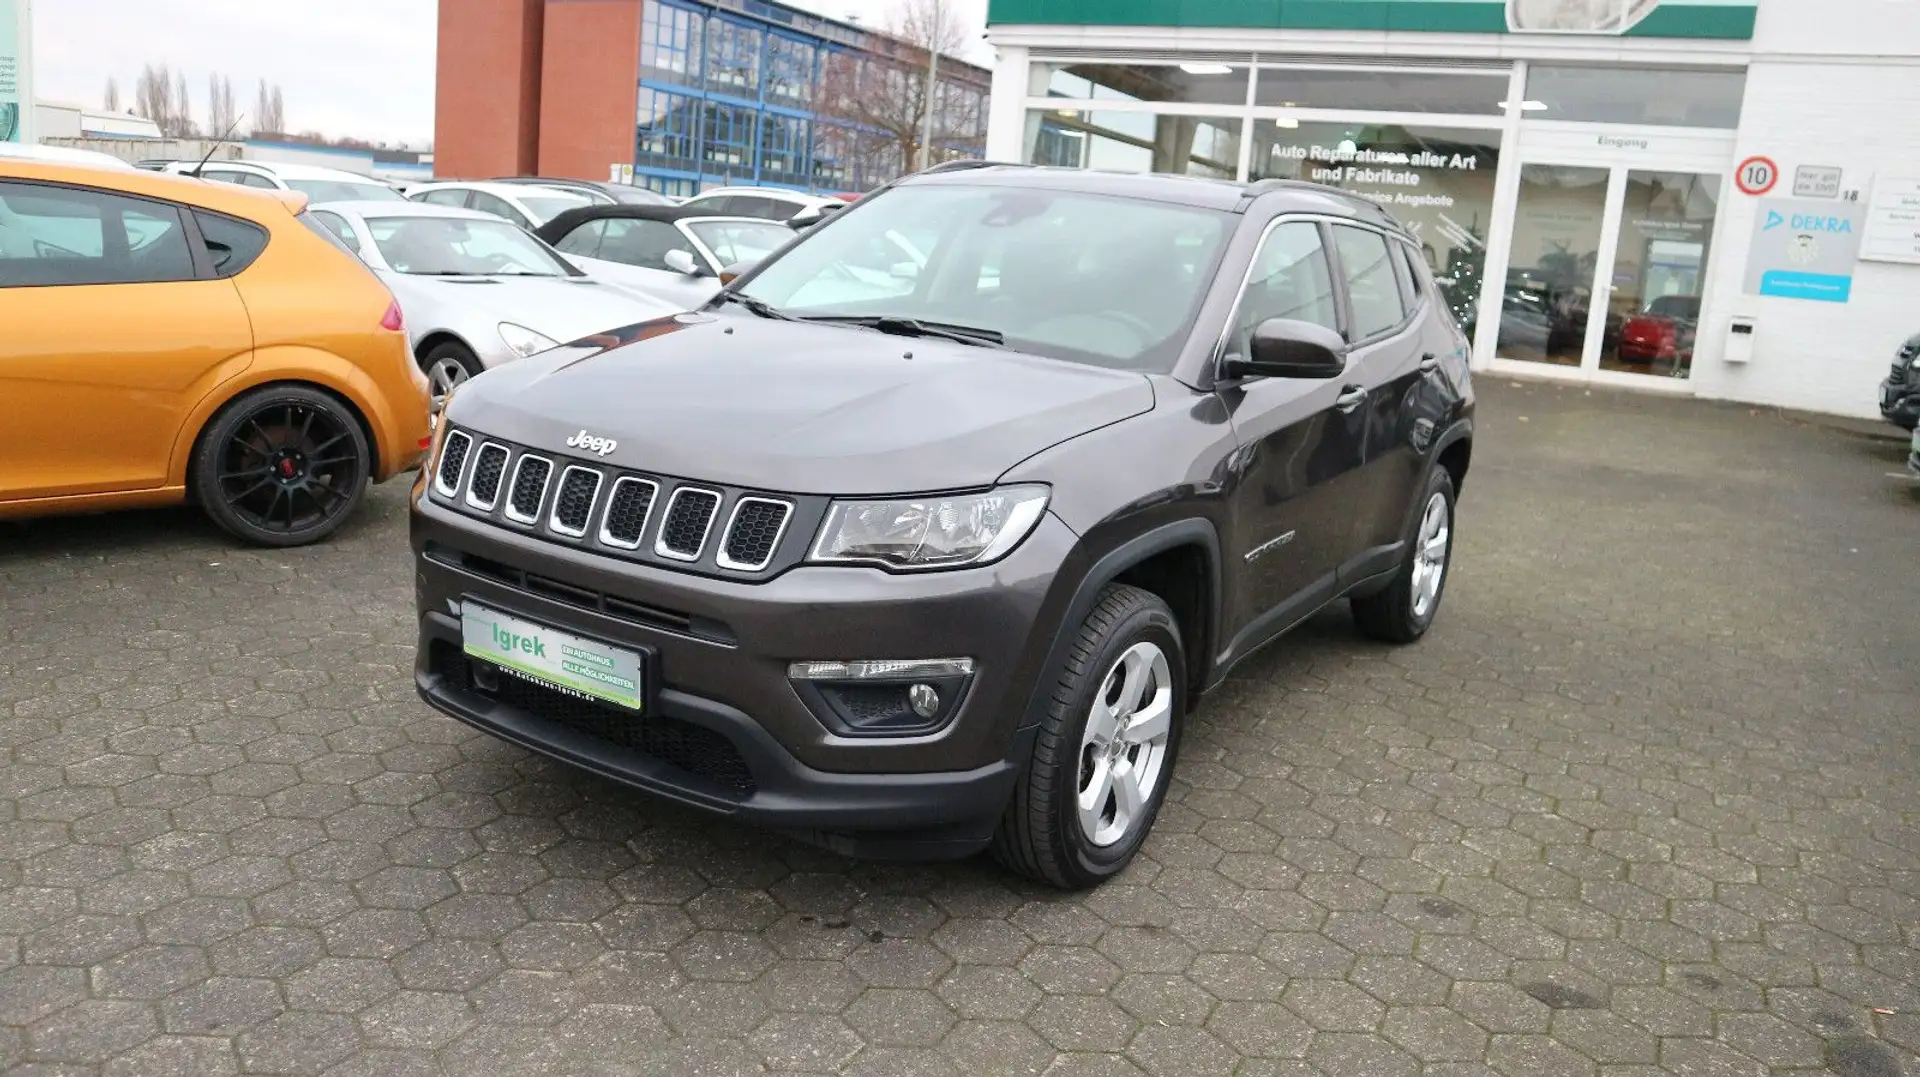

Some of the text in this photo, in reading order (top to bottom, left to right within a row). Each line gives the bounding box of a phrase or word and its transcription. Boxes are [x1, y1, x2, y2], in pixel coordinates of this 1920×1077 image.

[1597, 135, 1648, 150] Eingang
[1271, 143, 1477, 170] Auto Reparaturen aller Art
[1312, 167, 1420, 187] und Fabrikate
[1747, 167, 1767, 185] 10
[1394, 192, 1454, 208] Angebote
[1791, 214, 1851, 233] DEKRA
[566, 429, 617, 457] Jeep
[491, 622, 547, 659] Igrek
